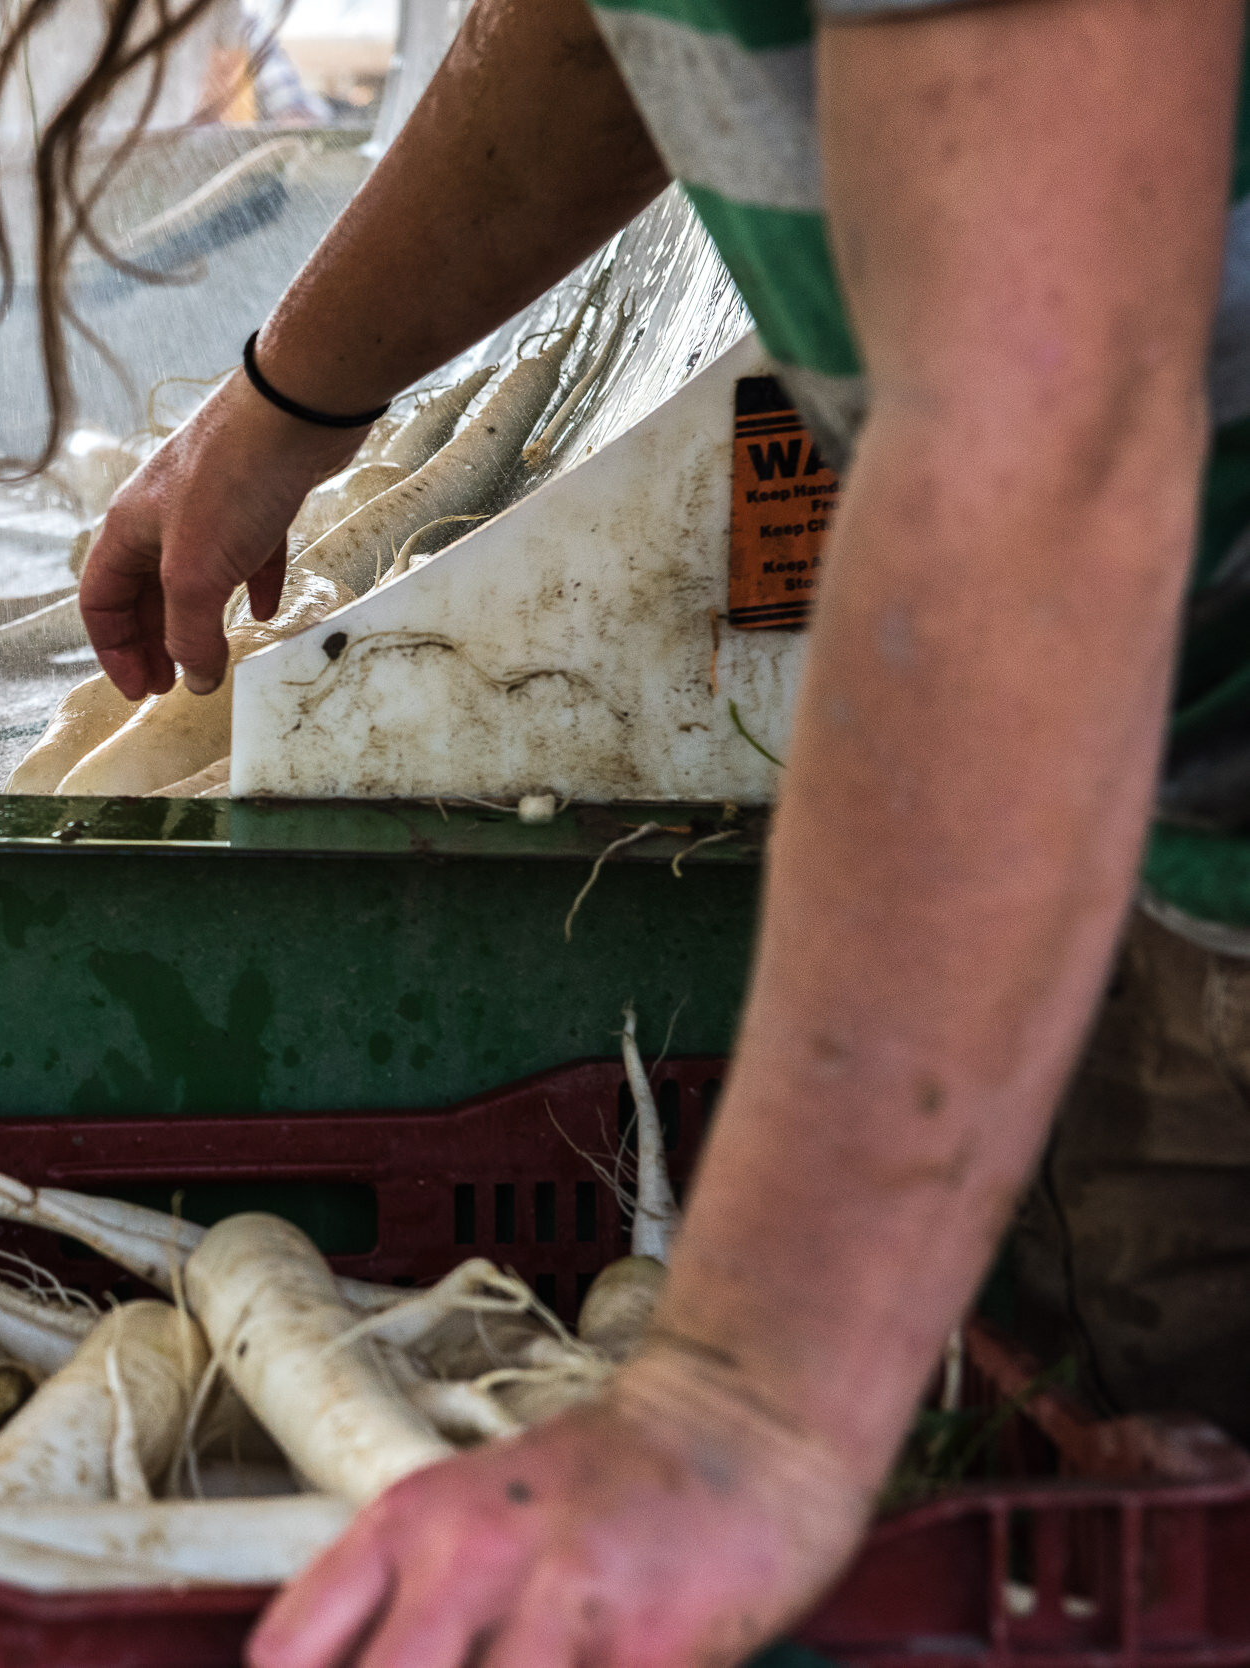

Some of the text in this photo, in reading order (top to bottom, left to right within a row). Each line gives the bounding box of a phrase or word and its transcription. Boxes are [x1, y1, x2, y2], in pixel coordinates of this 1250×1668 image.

[747, 438, 828, 481] WA
[746, 481, 840, 503] Keep Hand
[812, 499, 839, 512] Fro
[760, 524, 804, 538] Keep
[763, 560, 808, 574] Keep
[785, 578, 816, 591] Sto
